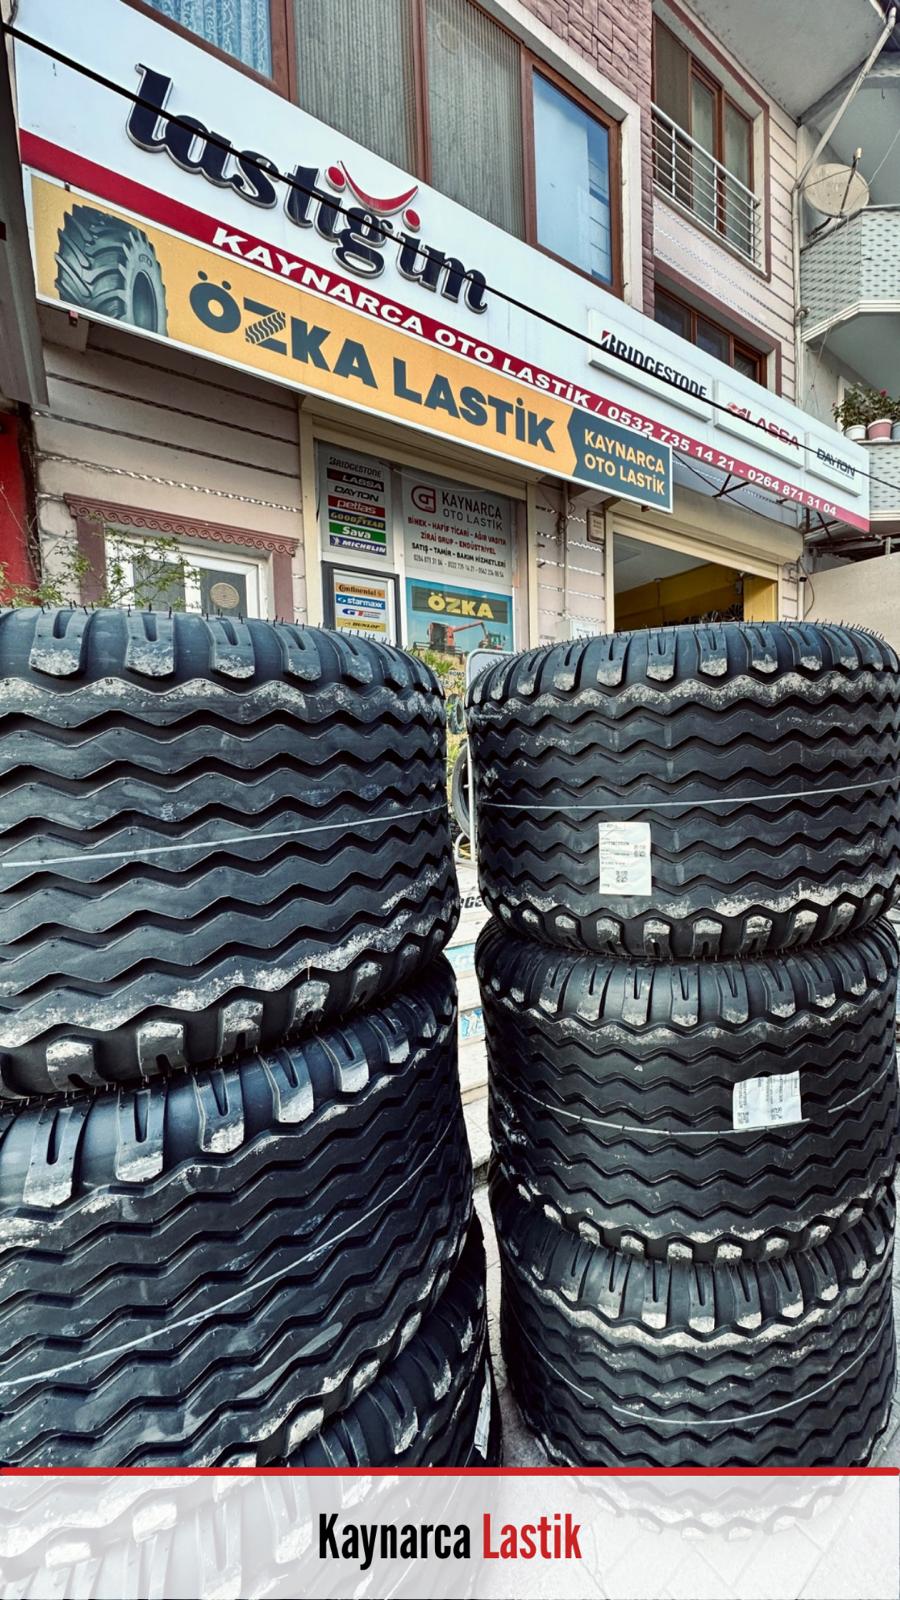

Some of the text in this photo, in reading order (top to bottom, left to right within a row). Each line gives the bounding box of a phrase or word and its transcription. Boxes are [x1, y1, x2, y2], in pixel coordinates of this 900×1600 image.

[189, 270, 555, 453] ÖZKA LASTİK
[601, 330, 707, 397] BRIDGESTONE
[213, 228, 424, 335] KAYNARCA
[435, 329, 494, 363] OTO
[502, 358, 591, 408] LASTİK
[595, 401, 602, 412] /
[608, 407, 654, 436] 0532
[661, 428, 690, 451] 735
[696, 446, 712, 462] 14
[718, 455, 734, 471] 21
[748, 468, 779, 490] 0264
[782, 484, 804, 501] 871
[807, 496, 820, 509] 31
[824, 502, 836, 516] 04
[584, 428, 664, 475] KAYNARCA
[329, 457, 382, 477] BRIDGESTONE
[584, 454, 664, 496] OTO LASTİK
[342, 474, 382, 489] LASSA
[334, 486, 379, 502] DAYTON
[337, 500, 376, 514] petlas
[442, 492, 502, 519] KAYNARCA
[331, 512, 384, 528] GOODYEAR
[443, 508, 502, 530] OTO LASTİK
[342, 526, 372, 540] Sava
[438, 536, 453, 545] GRUP
[342, 540, 386, 552] MICHELIN
[456, 552, 474, 562] BAKIM
[339, 584, 376, 595] Continental
[348, 598, 383, 608] starmaxx
[428, 592, 494, 619] ÖZKA
